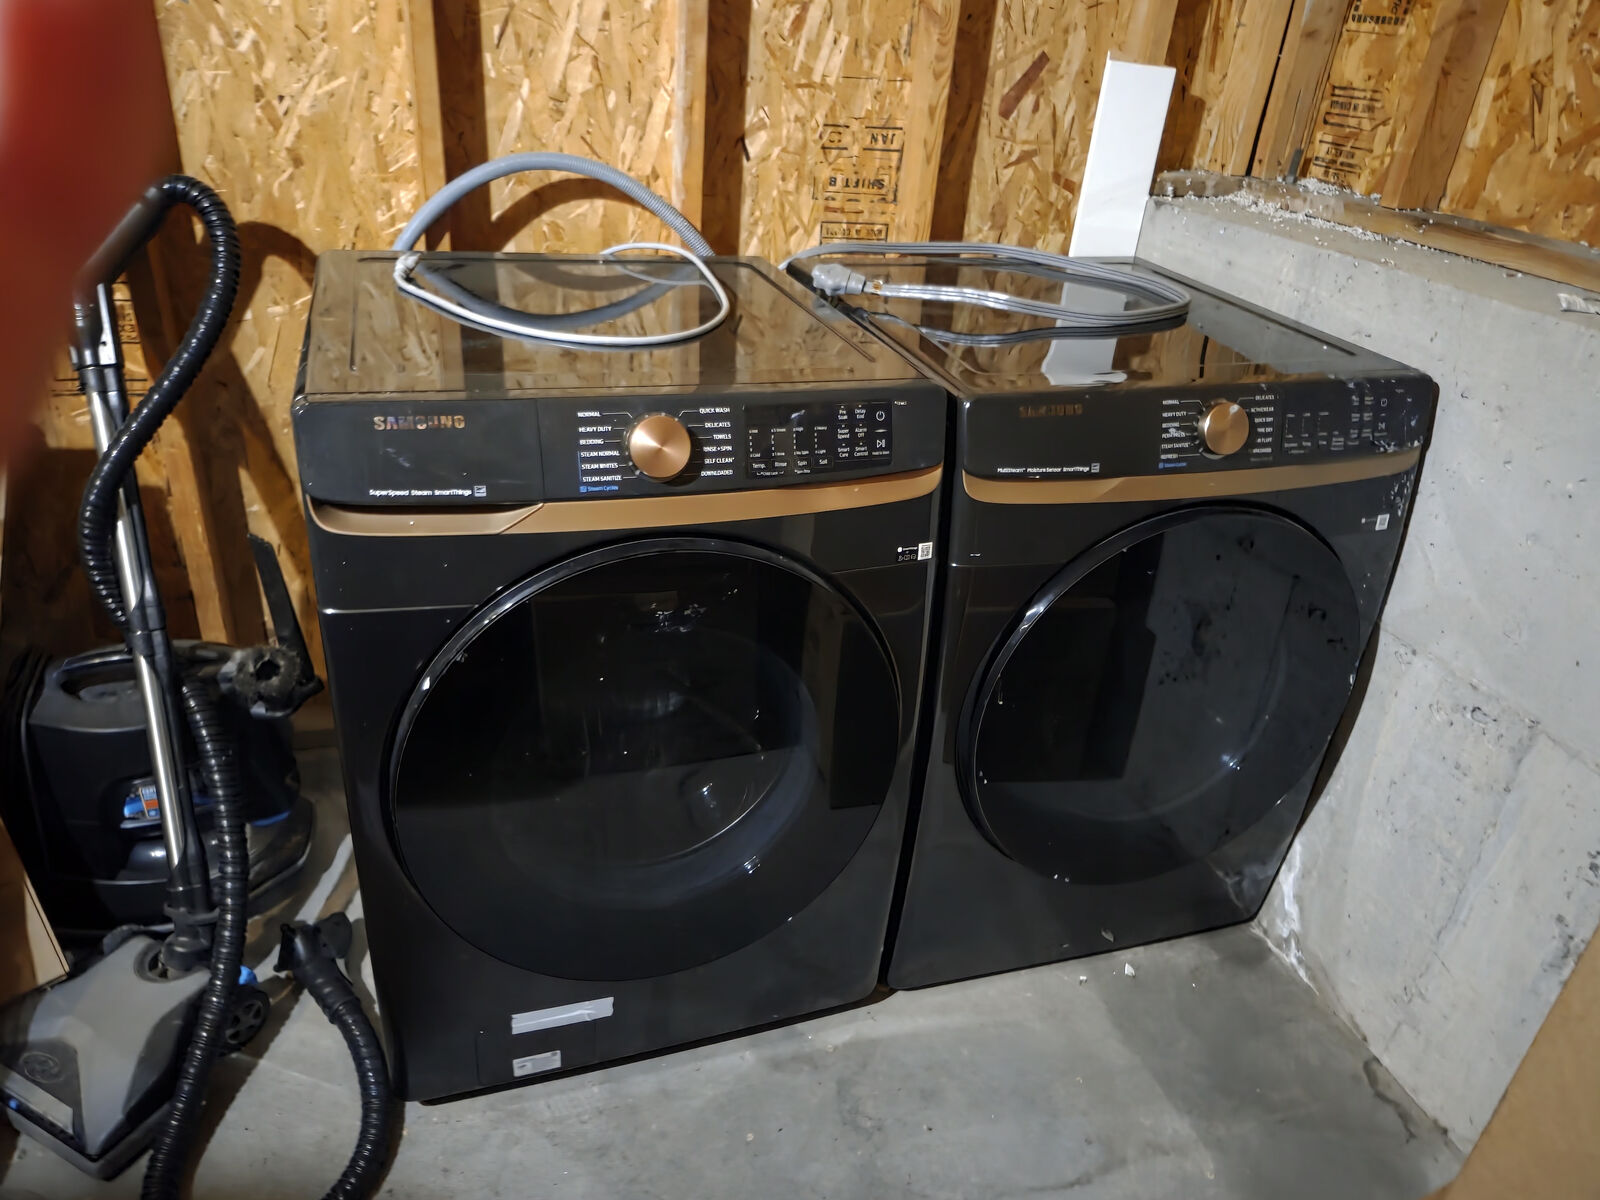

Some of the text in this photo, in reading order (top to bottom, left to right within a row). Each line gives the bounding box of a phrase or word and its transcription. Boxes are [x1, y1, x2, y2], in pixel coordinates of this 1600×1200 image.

[870, 133, 897, 145] JAN
[843, 177, 886, 190] SHIFT
[373, 415, 466, 431] SAMSUNG
[700, 469, 734, 477] DOWNLOADED
[368, 488, 472, 498] SuperSpeed Steam SmartThings
